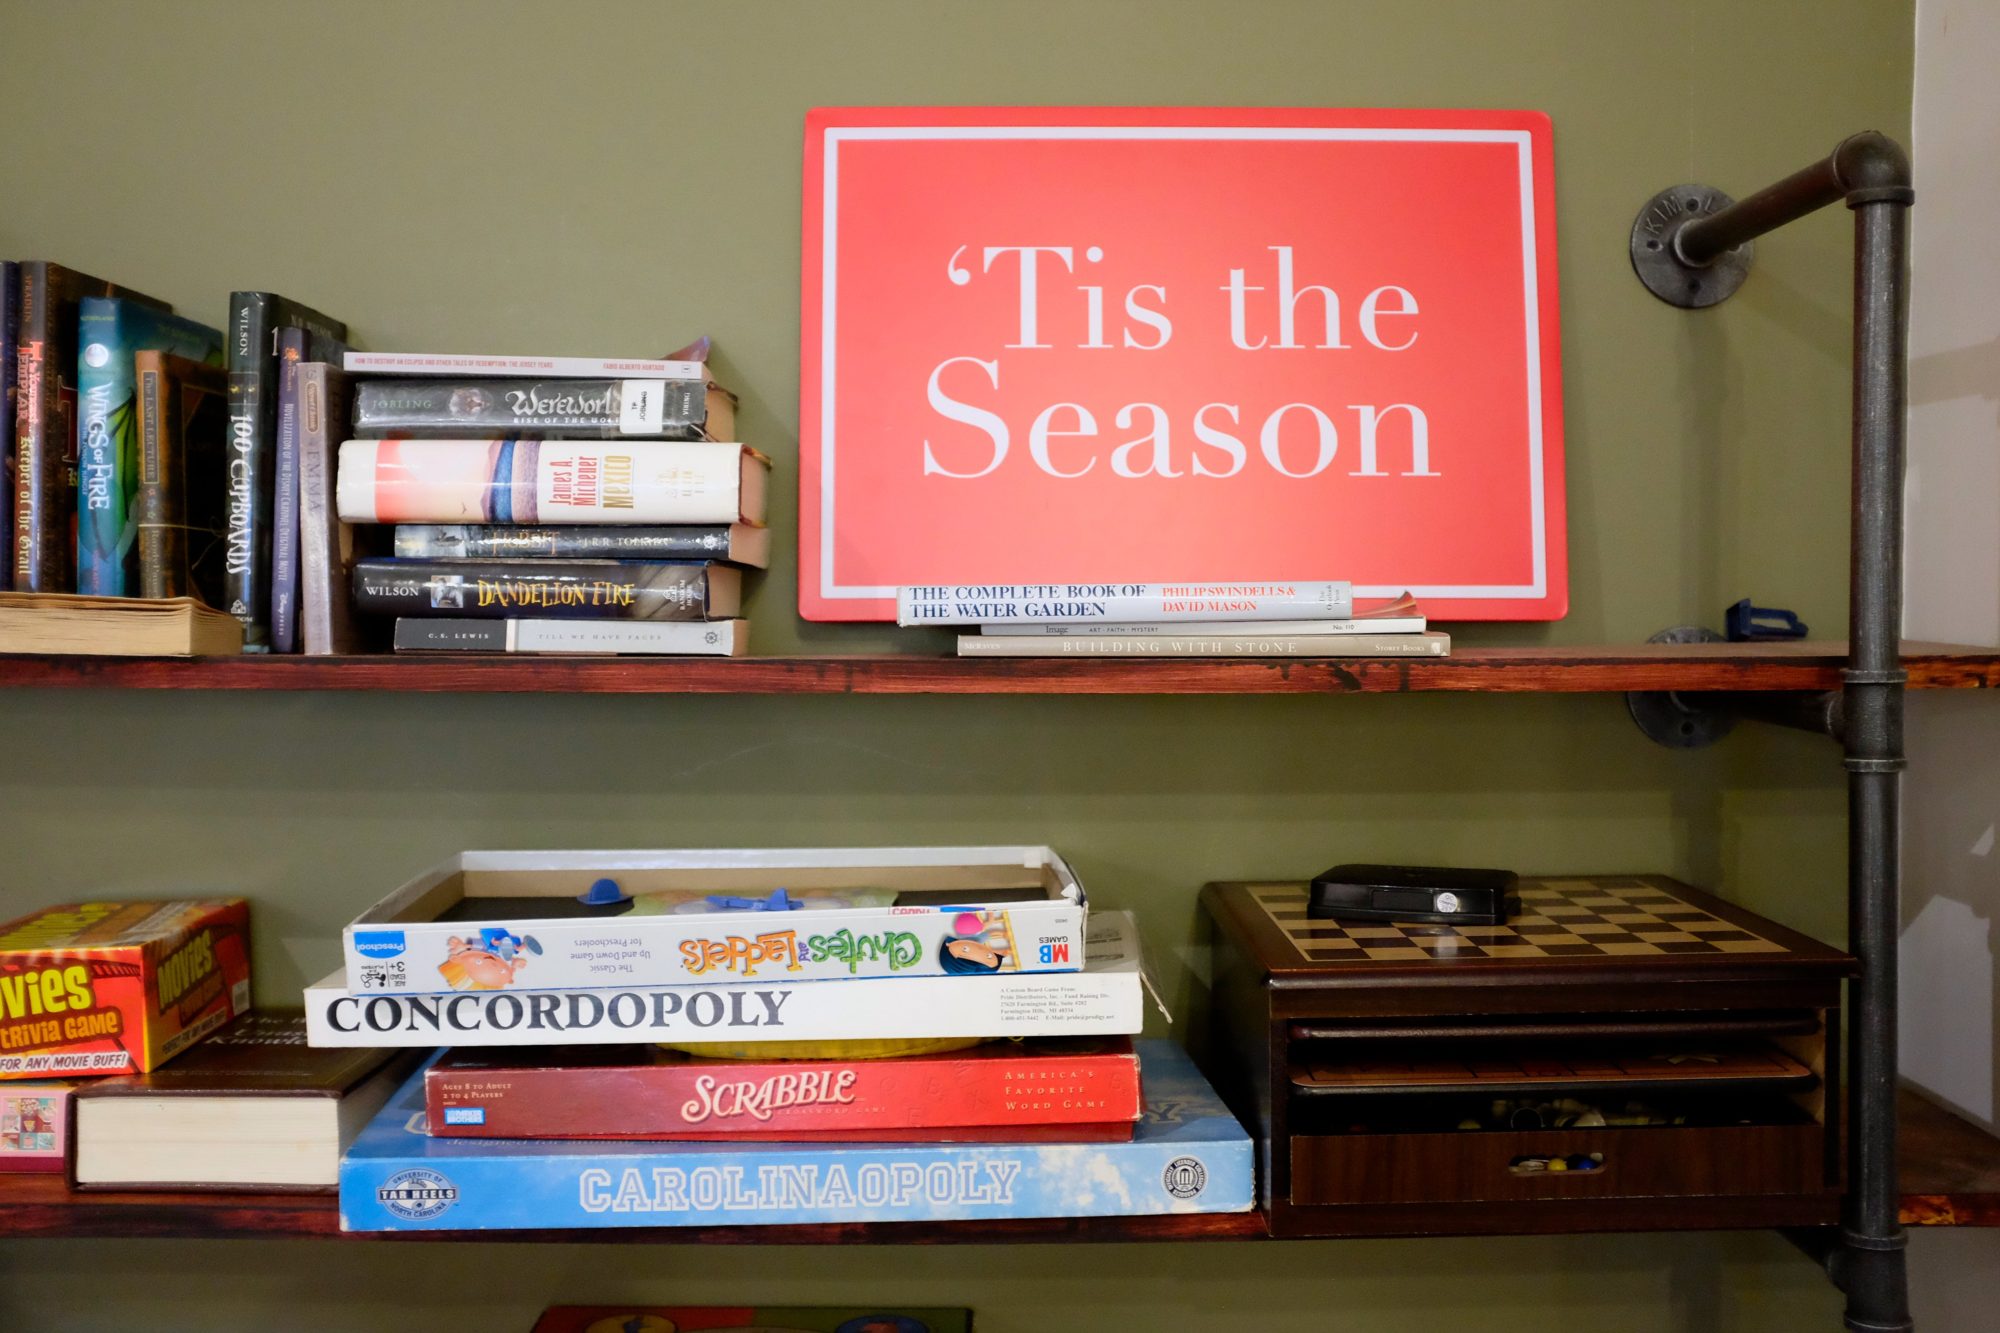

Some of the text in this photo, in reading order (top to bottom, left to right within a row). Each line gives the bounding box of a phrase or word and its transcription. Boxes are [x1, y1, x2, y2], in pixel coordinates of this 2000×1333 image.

[1645, 193, 1683, 236] KIM
[1219, 245, 1420, 351] the
[239, 306, 249, 357] WILSON
[145, 397, 154, 425] LAST
[922, 356, 1442, 479] Season
[513, 416, 539, 424] RISE
[544, 416, 557, 424] OF
[564, 416, 584, 424] THE
[230, 413, 253, 452] 100
[87, 382, 113, 510] WINGS OF FIRE
[145, 427, 155, 480] LECTURE
[307, 450, 322, 513] EMMA
[549, 456, 574, 506] James A.
[572, 456, 598, 506] Michener
[20, 491, 34, 507] of
[19, 509, 33, 531] the
[18, 535, 33, 575] Grail
[365, 585, 419, 597] WILSON
[477, 579, 636, 608] DANDELION FIRE
[908, 584, 1147, 601] THE COMPLETE BOOK OF
[1162, 586, 1208, 597] PHILIP
[1208, 586, 1286, 597] SWINDELLS
[909, 601, 1107, 618] THE WATER GARDEN
[1162, 600, 1257, 612] DAVID MASON
[454, 632, 490, 640] LEWIS
[1045, 625, 1069, 635] Image
[1062, 642, 1298, 653] BUILDING WITH STONE
[357, 943, 404, 951] Preschool
[573, 938, 628, 947] Preschoolers
[806, 928, 923, 974] Chutes
[570, 950, 651, 961] Up and Down Game
[678, 930, 797, 976] Ladders
[1039, 944, 1070, 963] MB
[389, 961, 405, 973] 3+
[590, 964, 634, 972] The Classic
[326, 990, 793, 1033] CONCORDOPOLY
[0, 1052, 127, 1070] FOR ANY MOVIE BUFF!
[1004, 1069, 1095, 1081] AMERICA'S
[442, 1083, 463, 1091] AGES
[471, 1091, 504, 1099] PLAYERS
[1005, 1086, 1086, 1095] FAVORITE
[680, 1069, 857, 1123] SCRABBLE
[1006, 1100, 1106, 1111] WORD GAME
[392, 1171, 432, 1184] UNIVERSITY
[381, 1189, 454, 1200] TAR HEELS
[579, 1160, 1021, 1214] CAROLINAOPOLY
[390, 1202, 447, 1218] NORTH CAROLINA
